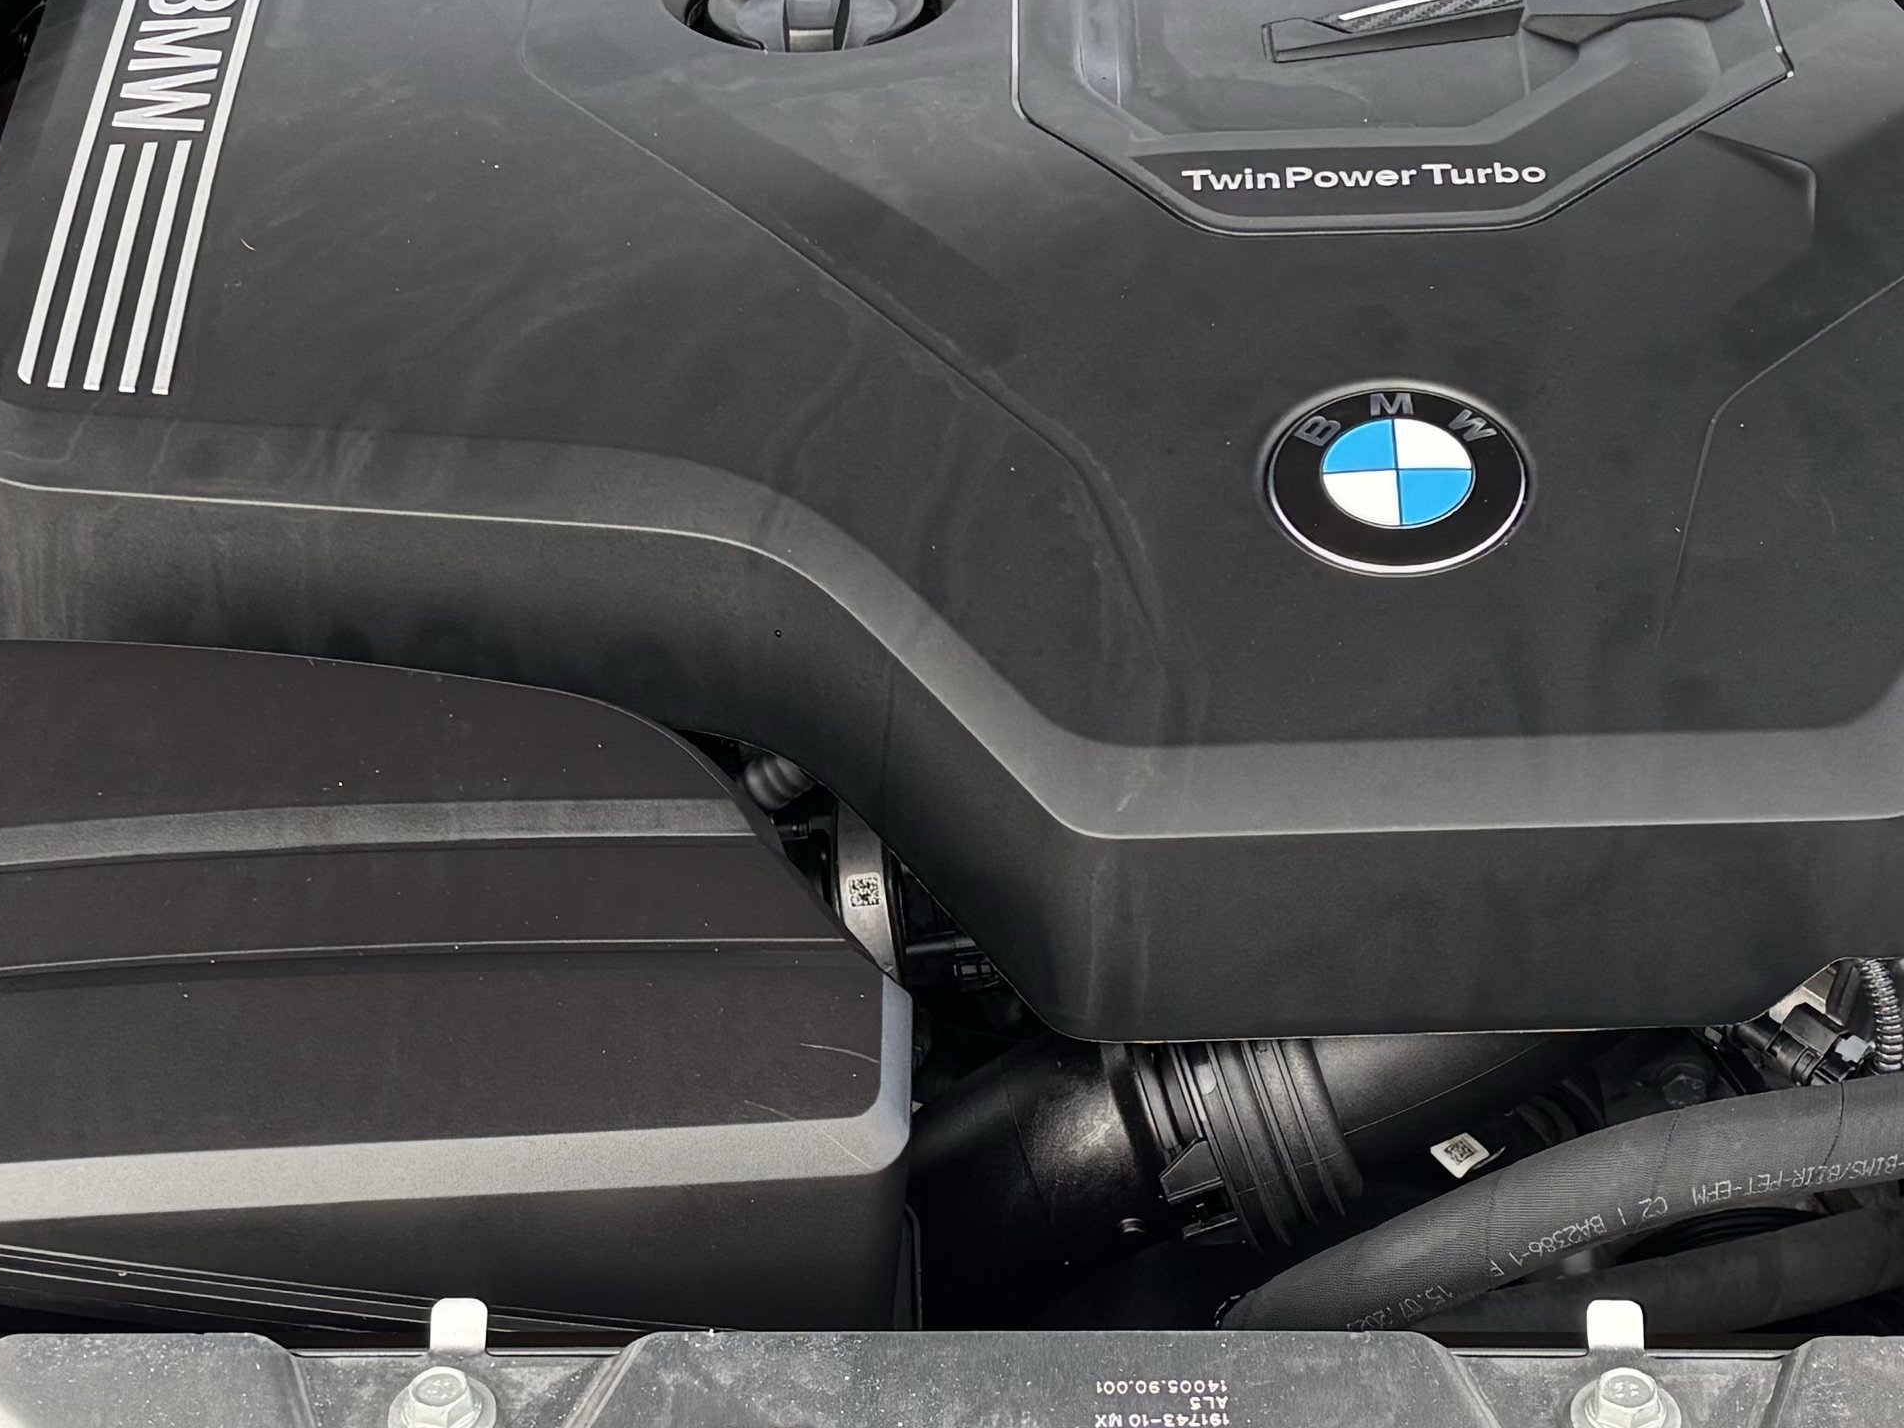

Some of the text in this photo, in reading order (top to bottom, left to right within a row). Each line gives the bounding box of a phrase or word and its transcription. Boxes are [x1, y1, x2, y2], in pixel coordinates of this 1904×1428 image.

[1182, 162, 1546, 191] TwinPower Turbo
[1296, 392, 1497, 447] BMW
[1095, 1379, 1227, 1393] 14005.90.001
[1095, 1413, 1229, 1427] 191743-10 MX
